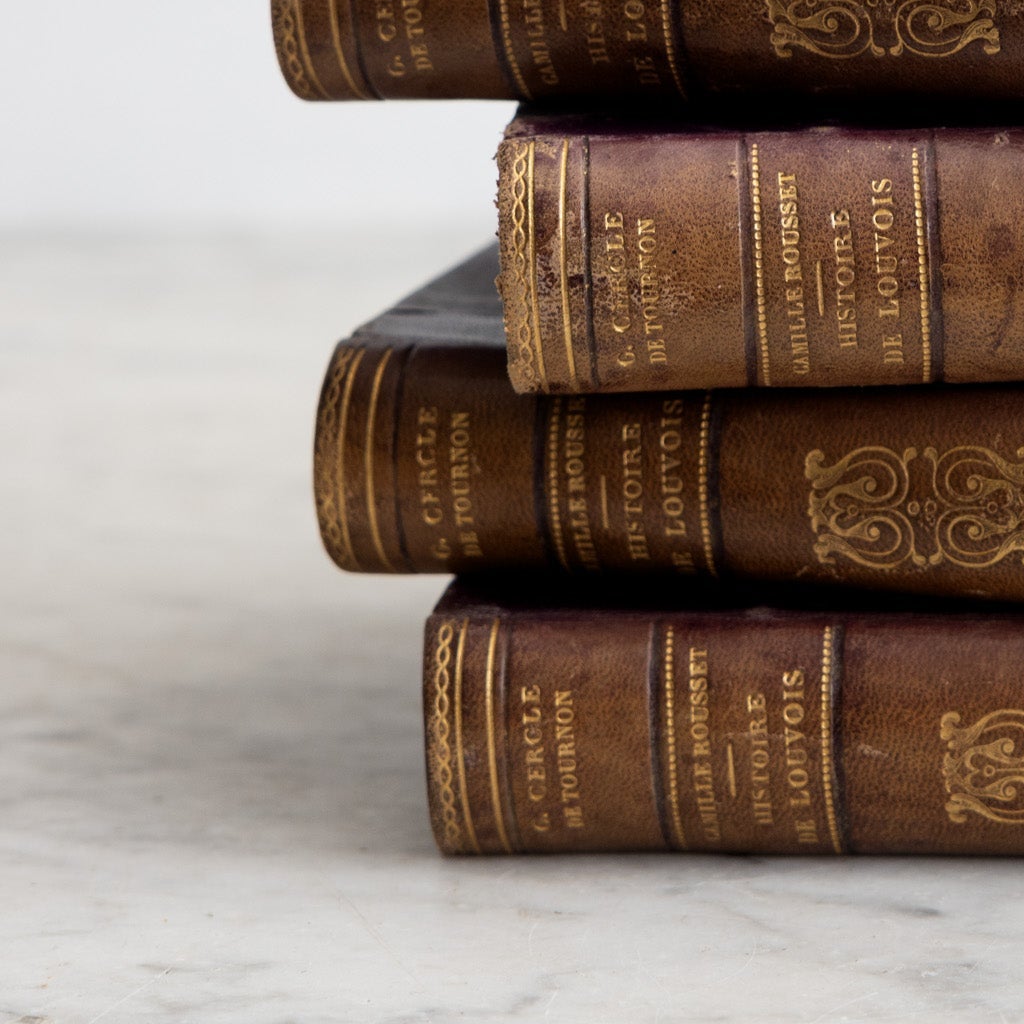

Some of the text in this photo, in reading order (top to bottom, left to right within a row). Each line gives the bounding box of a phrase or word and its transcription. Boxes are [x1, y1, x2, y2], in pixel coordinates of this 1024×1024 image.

[411, 43, 433, 70] DE
[637, 217, 667, 363] DE TOURNON
[778, 171, 810, 375] CAMILLE ROUSSET
[831, 209, 858, 348] HISTOIRE
[871, 178, 904, 364] DE LOUVOIS
[450, 412, 474, 526] TOURNON
[565, 397, 586, 492] ROUSSE
[623, 423, 650, 560] HISTOIRE
[660, 399, 687, 536] LOUVOIS
[522, 684, 547, 801] CERCLE
[555, 690, 585, 828] DE TOURNON
[689, 648, 711, 756] ROUSSET
[747, 693, 773, 824] HISTOIRE
[783, 669, 818, 843] DE LOUVOIS
